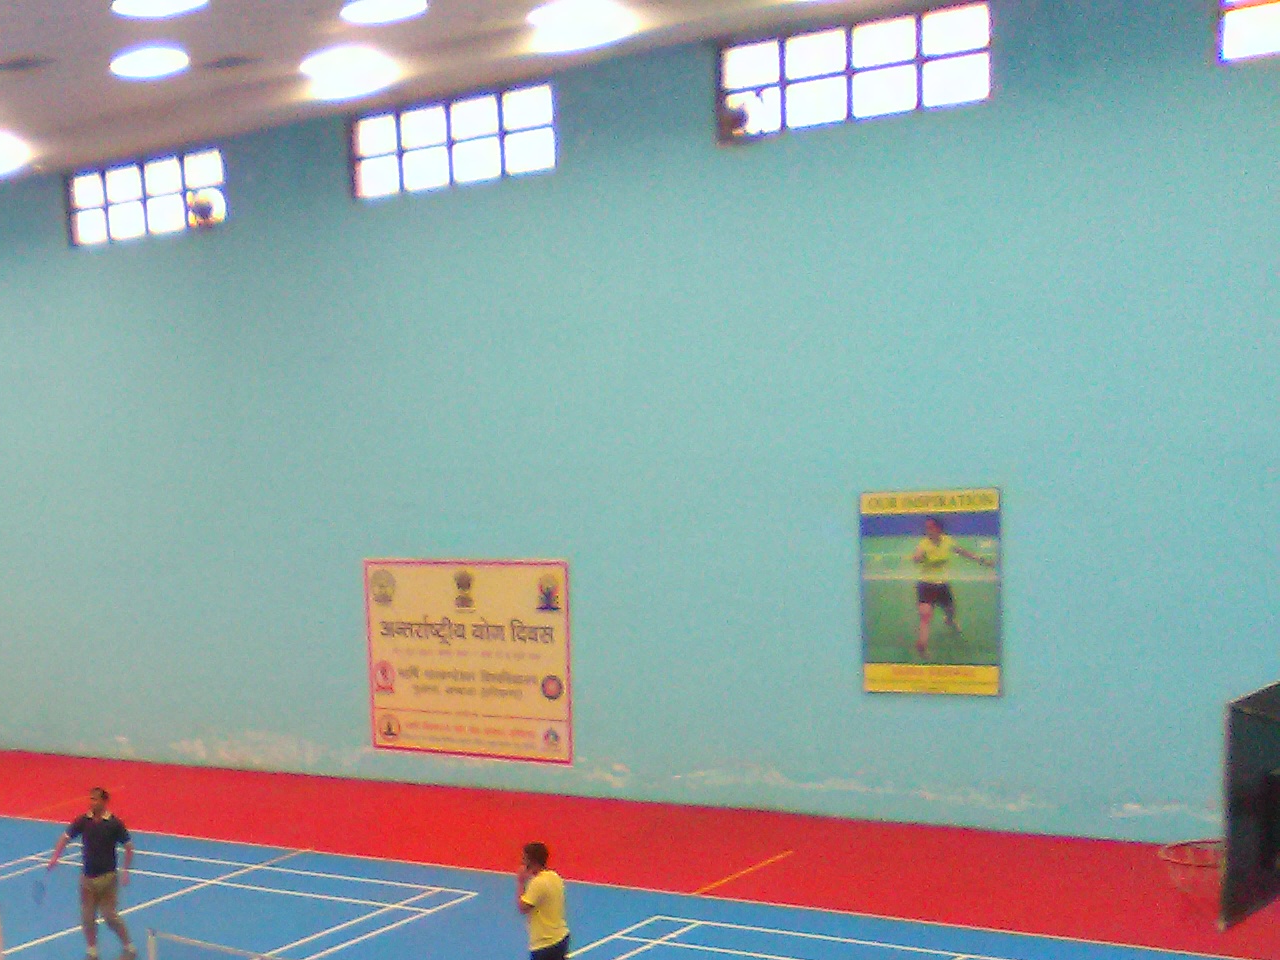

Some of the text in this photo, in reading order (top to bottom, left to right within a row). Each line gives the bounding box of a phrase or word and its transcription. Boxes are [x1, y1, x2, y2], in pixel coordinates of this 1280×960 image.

[869, 494, 994, 509] OUR INSPIRATION
[472, 616, 505, 642] योग
[510, 618, 554, 644] दिवस
